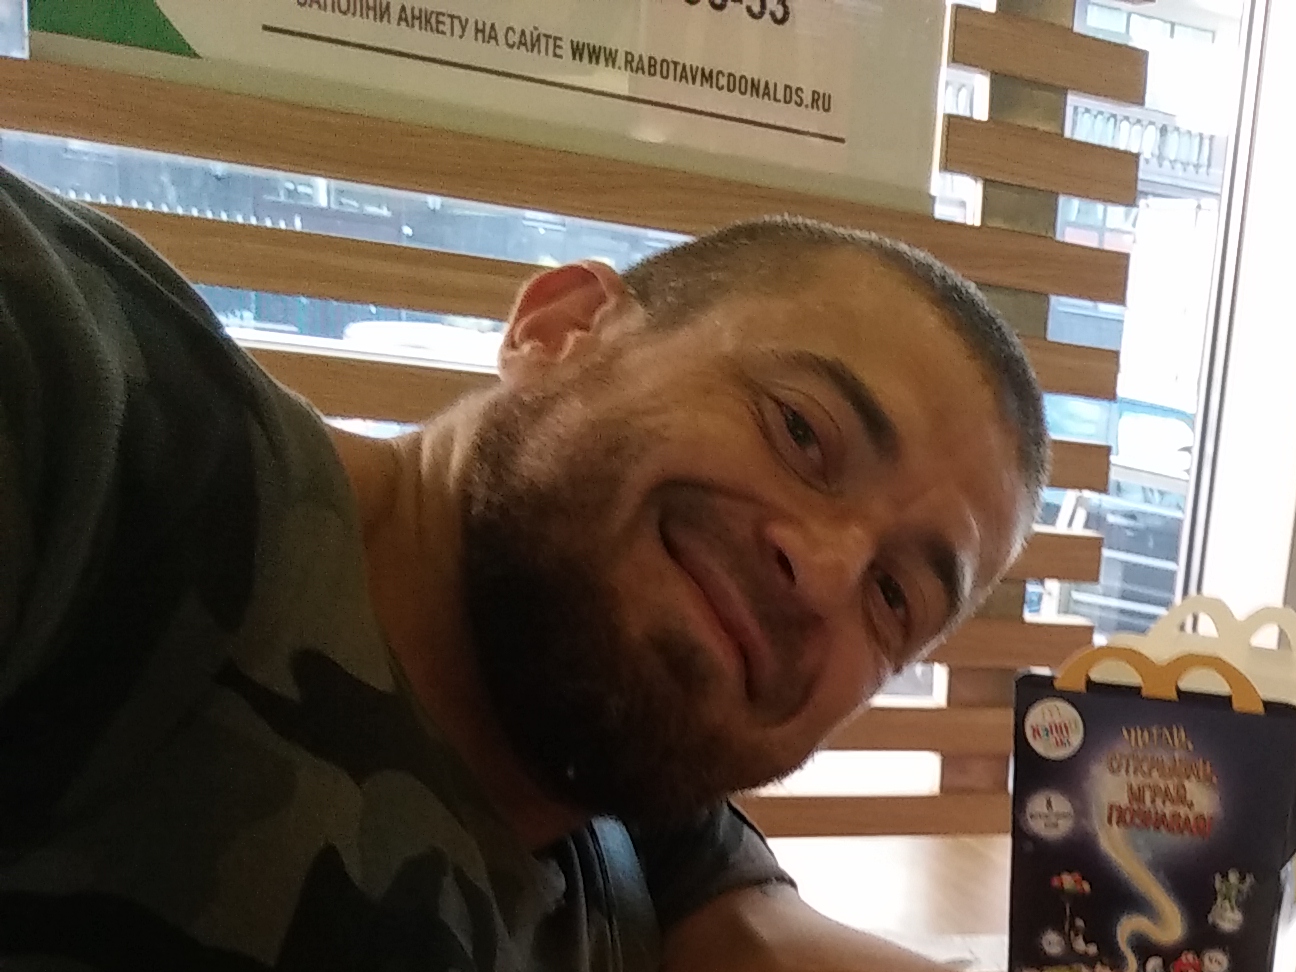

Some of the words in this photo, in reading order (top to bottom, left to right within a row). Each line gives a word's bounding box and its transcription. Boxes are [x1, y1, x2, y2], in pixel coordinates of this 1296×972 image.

[296, 0, 391, 24] ПОЛНИ
[396, 4, 469, 39] АНКЕТУ
[474, 18, 499, 46] НА
[504, 25, 563, 59] САЙТЕ
[570, 39, 832, 113] WWW.RABOTAVMCDONALDS.RU
